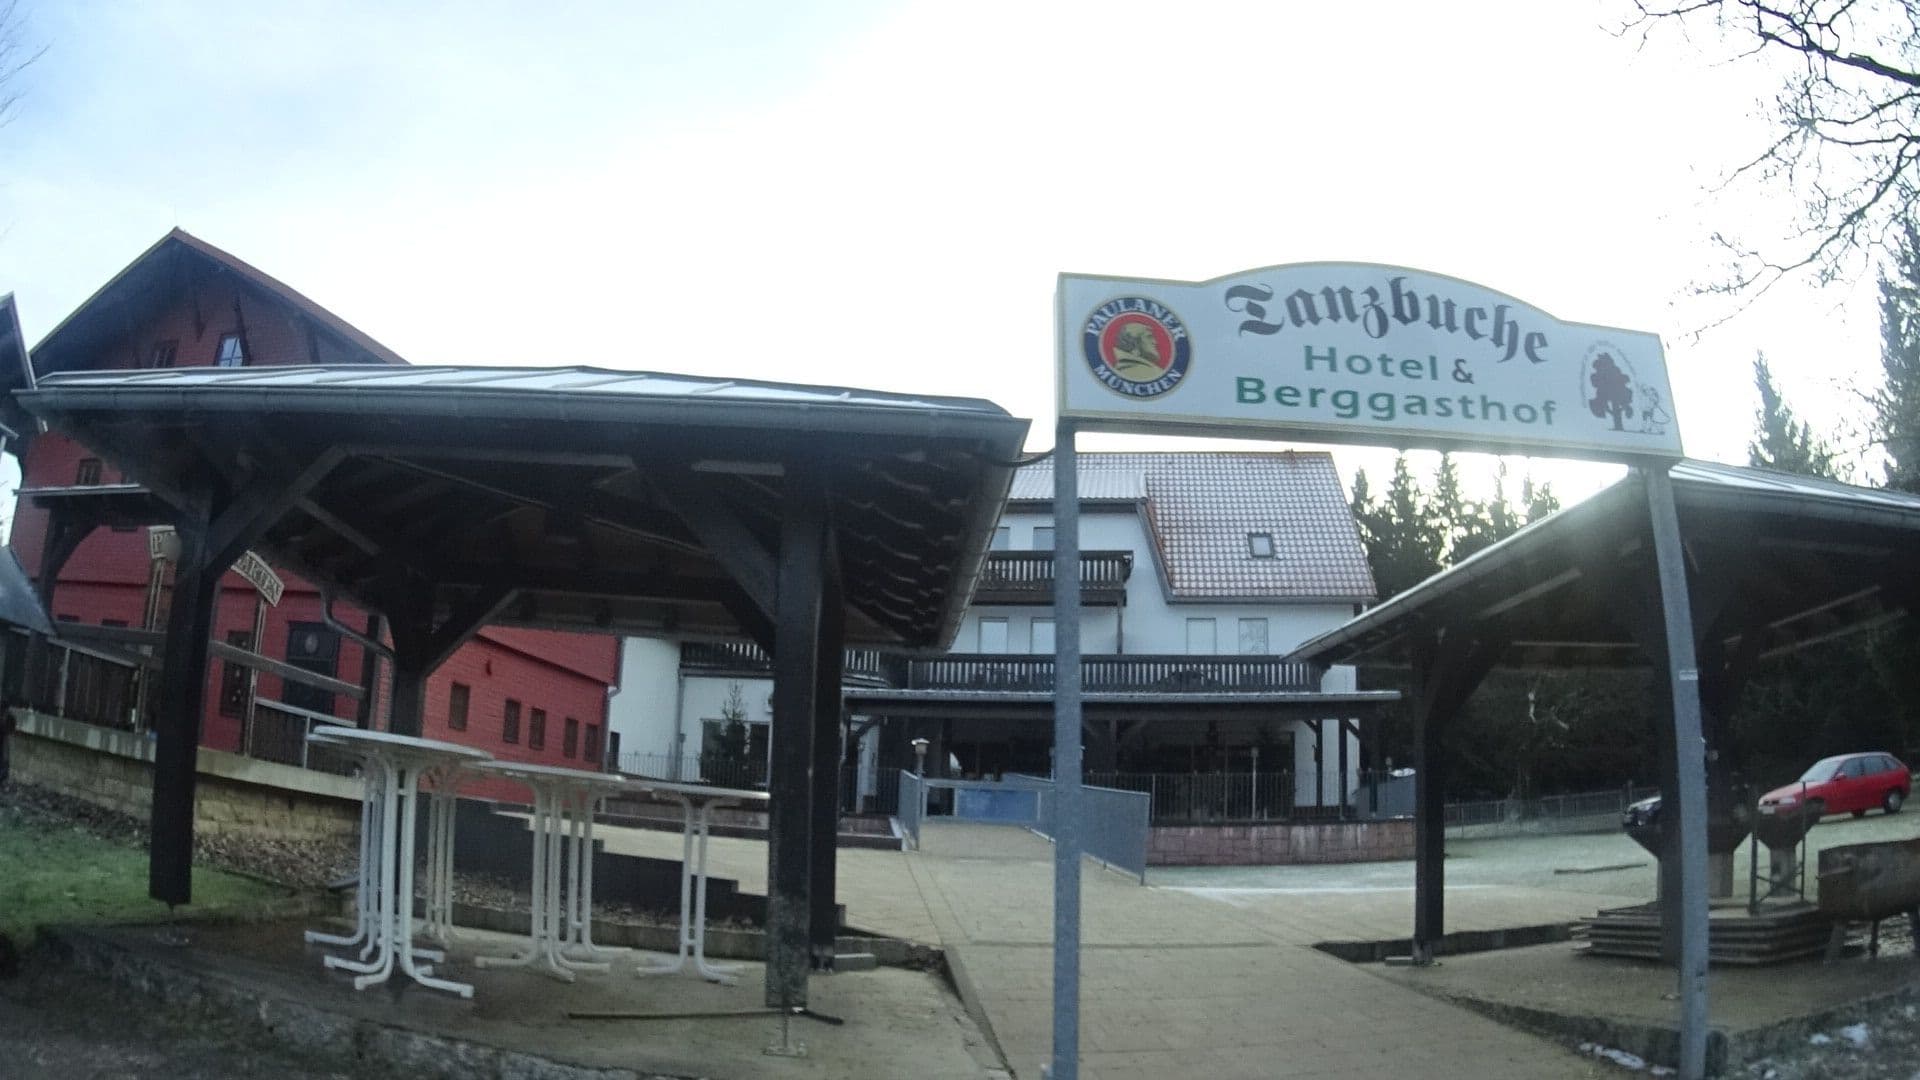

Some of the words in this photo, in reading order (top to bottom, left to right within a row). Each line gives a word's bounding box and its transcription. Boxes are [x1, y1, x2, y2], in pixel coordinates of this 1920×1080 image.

[1087, 298, 1186, 341] PAULANER
[1224, 276, 1549, 364] Tanzbuche
[1303, 345, 1439, 381] Hotel
[1452, 357, 1475, 385] &
[1235, 375, 1557, 426] Berggasthof
